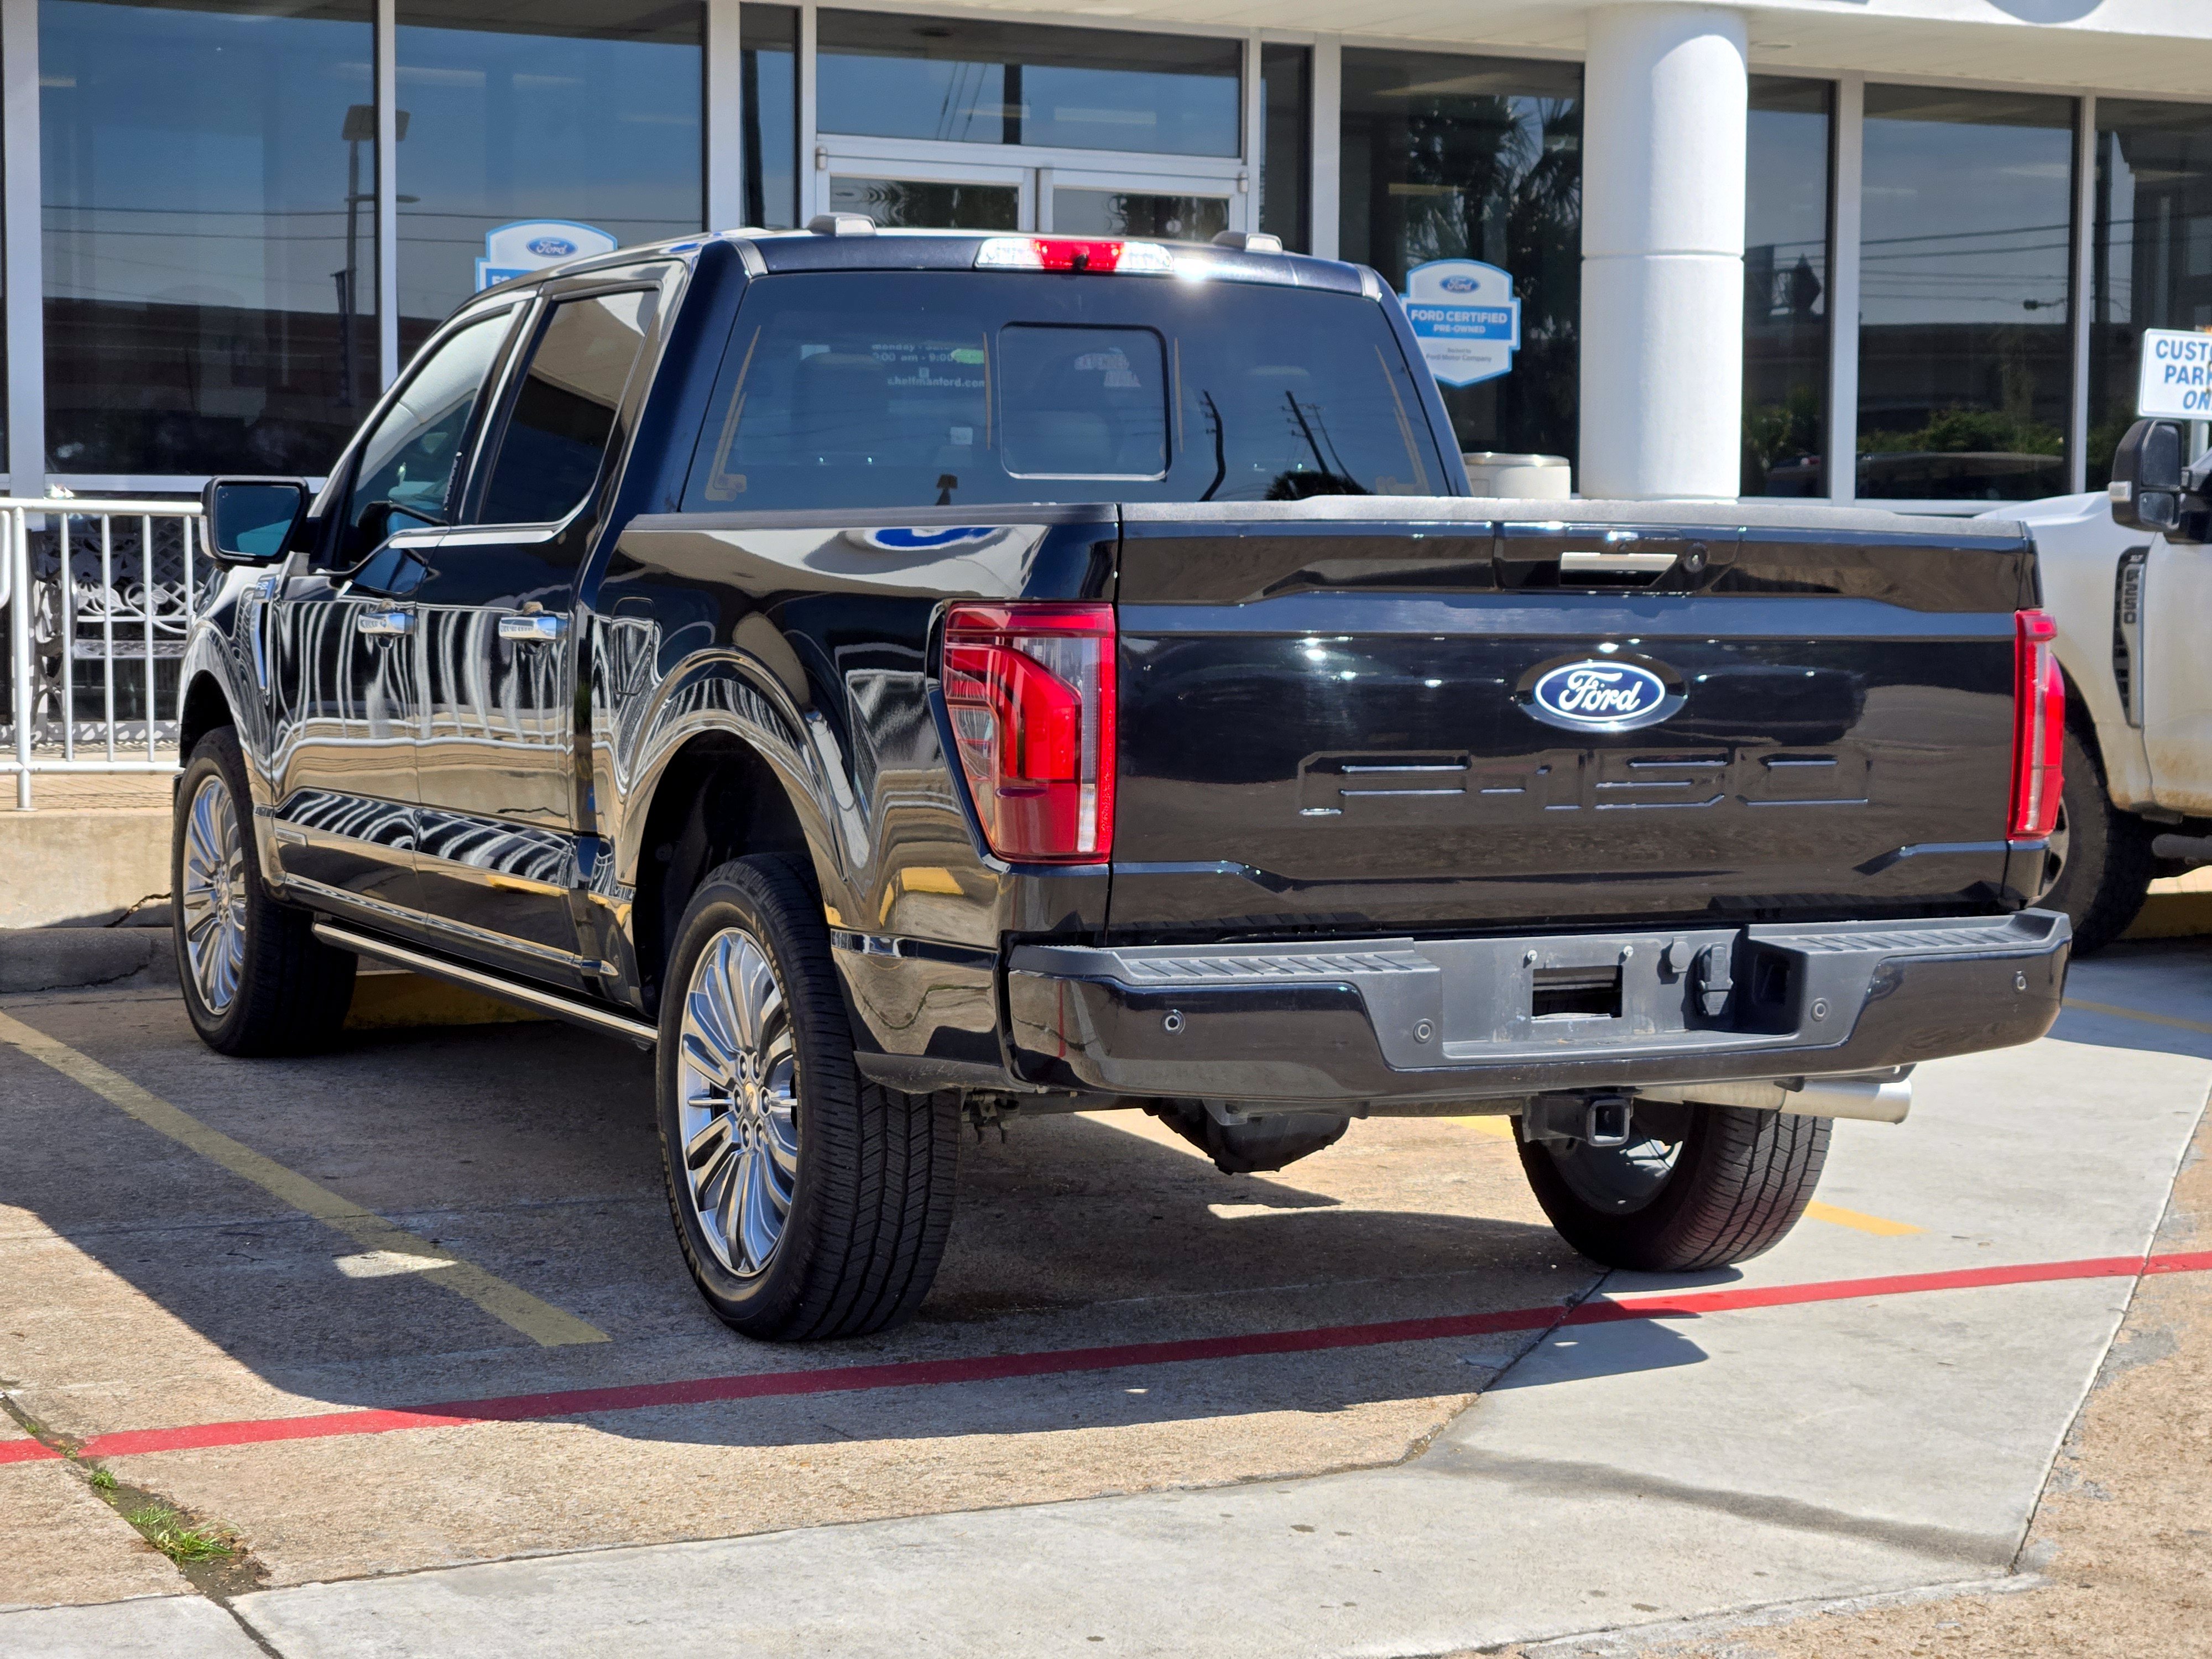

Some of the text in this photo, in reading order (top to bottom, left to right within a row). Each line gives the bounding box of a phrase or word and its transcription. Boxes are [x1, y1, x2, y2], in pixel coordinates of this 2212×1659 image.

[1411, 309, 1508, 324] FORD CERTIFIED
[1433, 324, 1486, 334] PRE-OWNED
[2156, 339, 2212, 361] CUST
[2182, 389, 2212, 410] ON
[1558, 670, 1643, 711] Ford
[1300, 749, 1871, 815] F-150
[765, 942, 797, 1053] MICHELIN
